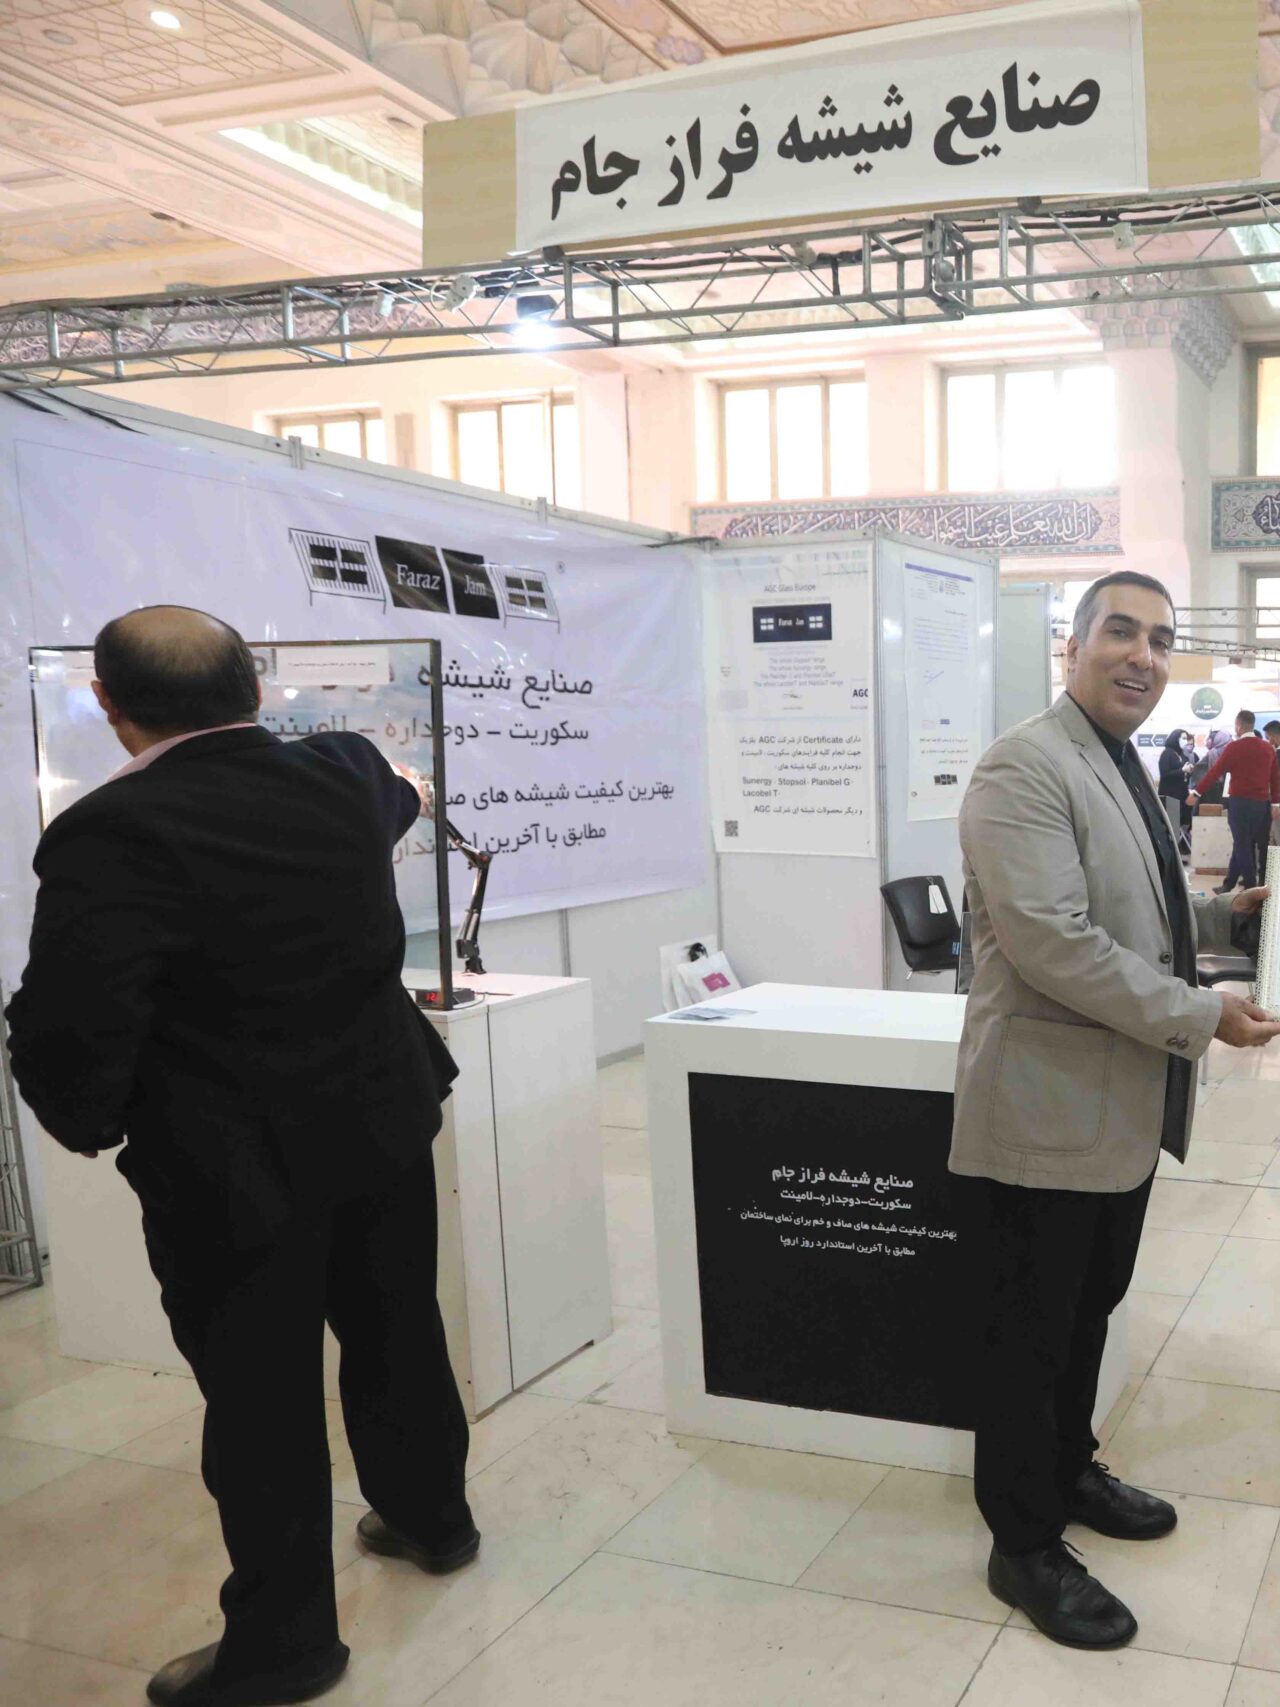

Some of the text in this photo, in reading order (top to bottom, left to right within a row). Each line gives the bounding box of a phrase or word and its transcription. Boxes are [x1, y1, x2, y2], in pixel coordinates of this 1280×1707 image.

[551, 61, 1100, 221] صنایع شیشه فراز جام
[397, 563, 486, 595] Faraz Jam
[417, 660, 511, 698] شیشه
[521, 669, 594, 709] صنایع
[509, 721, 589, 747] سکوریت
[758, 736, 776, 744] AGC
[803, 735, 844, 744] Certificate
[574, 780, 623, 805] کیفیت
[628, 781, 675, 802] بهترین
[743, 789, 772, 797] Lacobel
[811, 778, 842, 786] Planibel
[473, 786, 509, 811] های
[514, 783, 570, 807] شیشه
[754, 805, 771, 813] AGC
[485, 823, 540, 855] آخرین
[545, 825, 558, 844] با
[562, 823, 607, 848] مطابق
[772, 1165, 914, 1193] صنایع شیشه فراز جام
[740, 1206, 957, 1241] بهترین کیفیت شیشه های صاف و خم برای نمای ساختمان
[780, 1234, 915, 1257] مطابق با آخرین استاندارد روز اروپا
